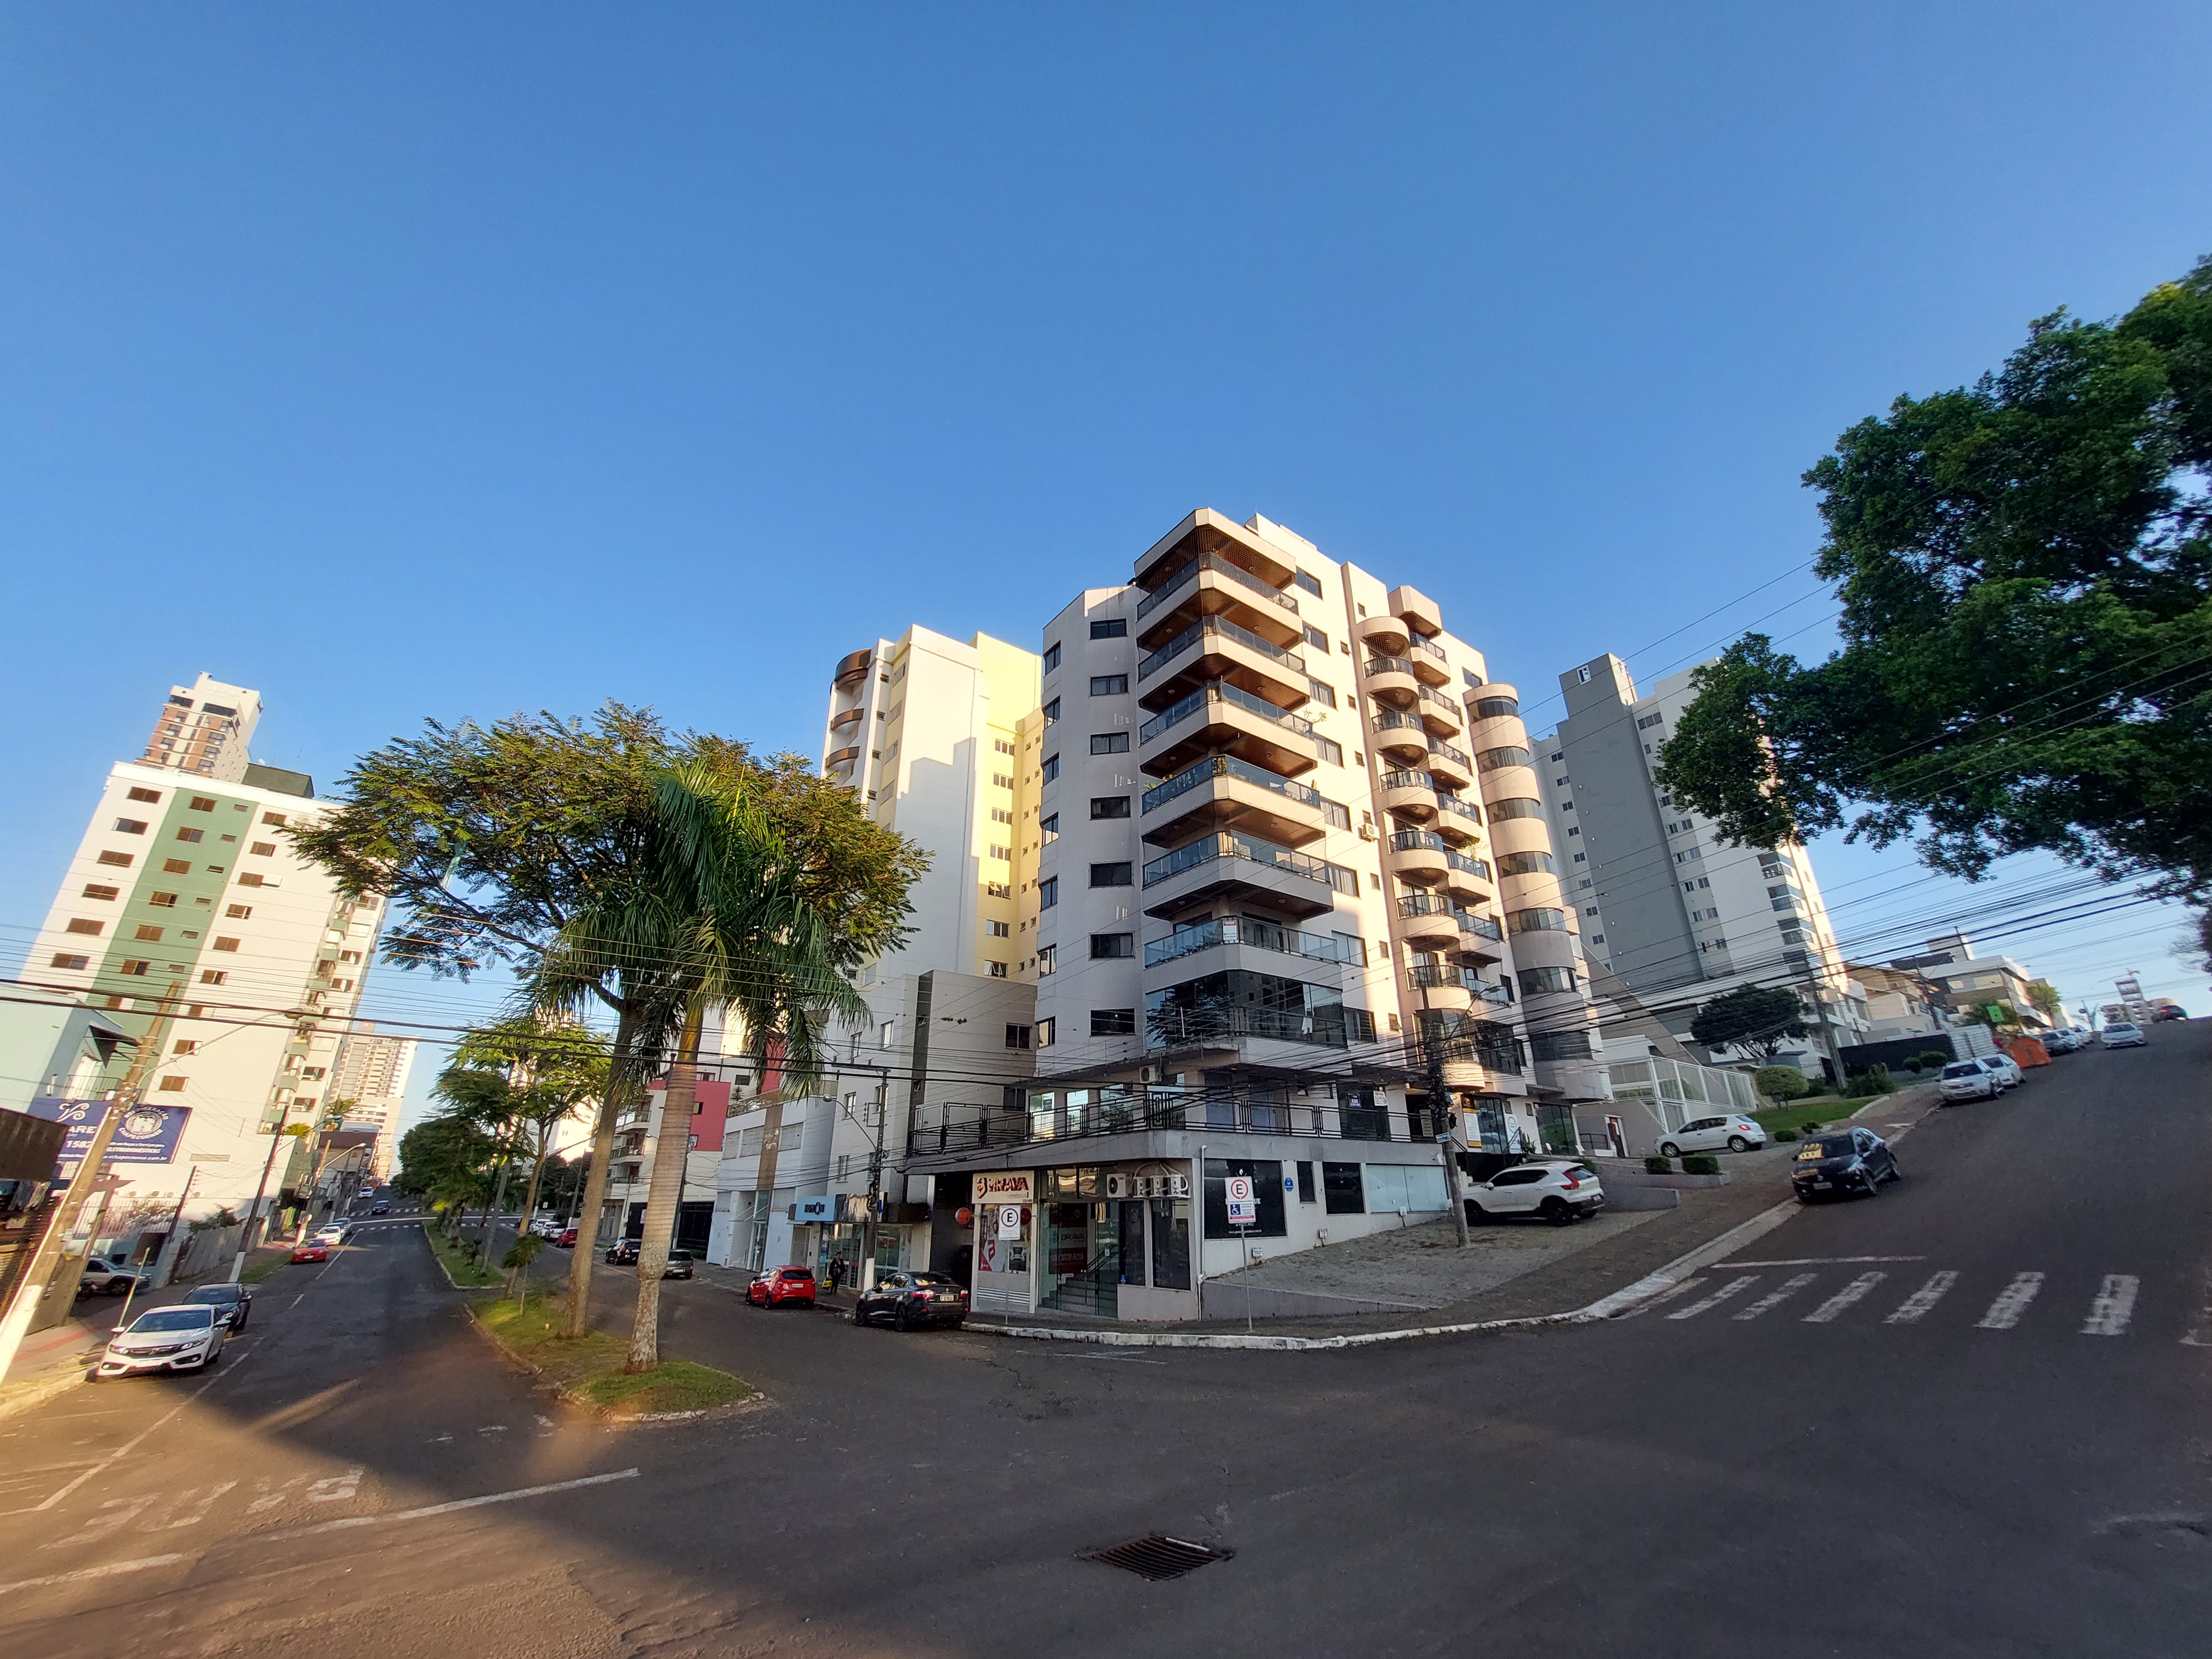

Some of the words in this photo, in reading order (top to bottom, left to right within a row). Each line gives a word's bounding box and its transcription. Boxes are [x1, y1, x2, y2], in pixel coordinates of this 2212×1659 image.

[118, 1127, 164, 1140] CHAPECOENSE
[988, 1177, 1029, 1192] BRAVA
[1236, 1184, 1243, 1194] E
[804, 1201, 825, 1215] KUMON
[1007, 1213, 1013, 1222] E
